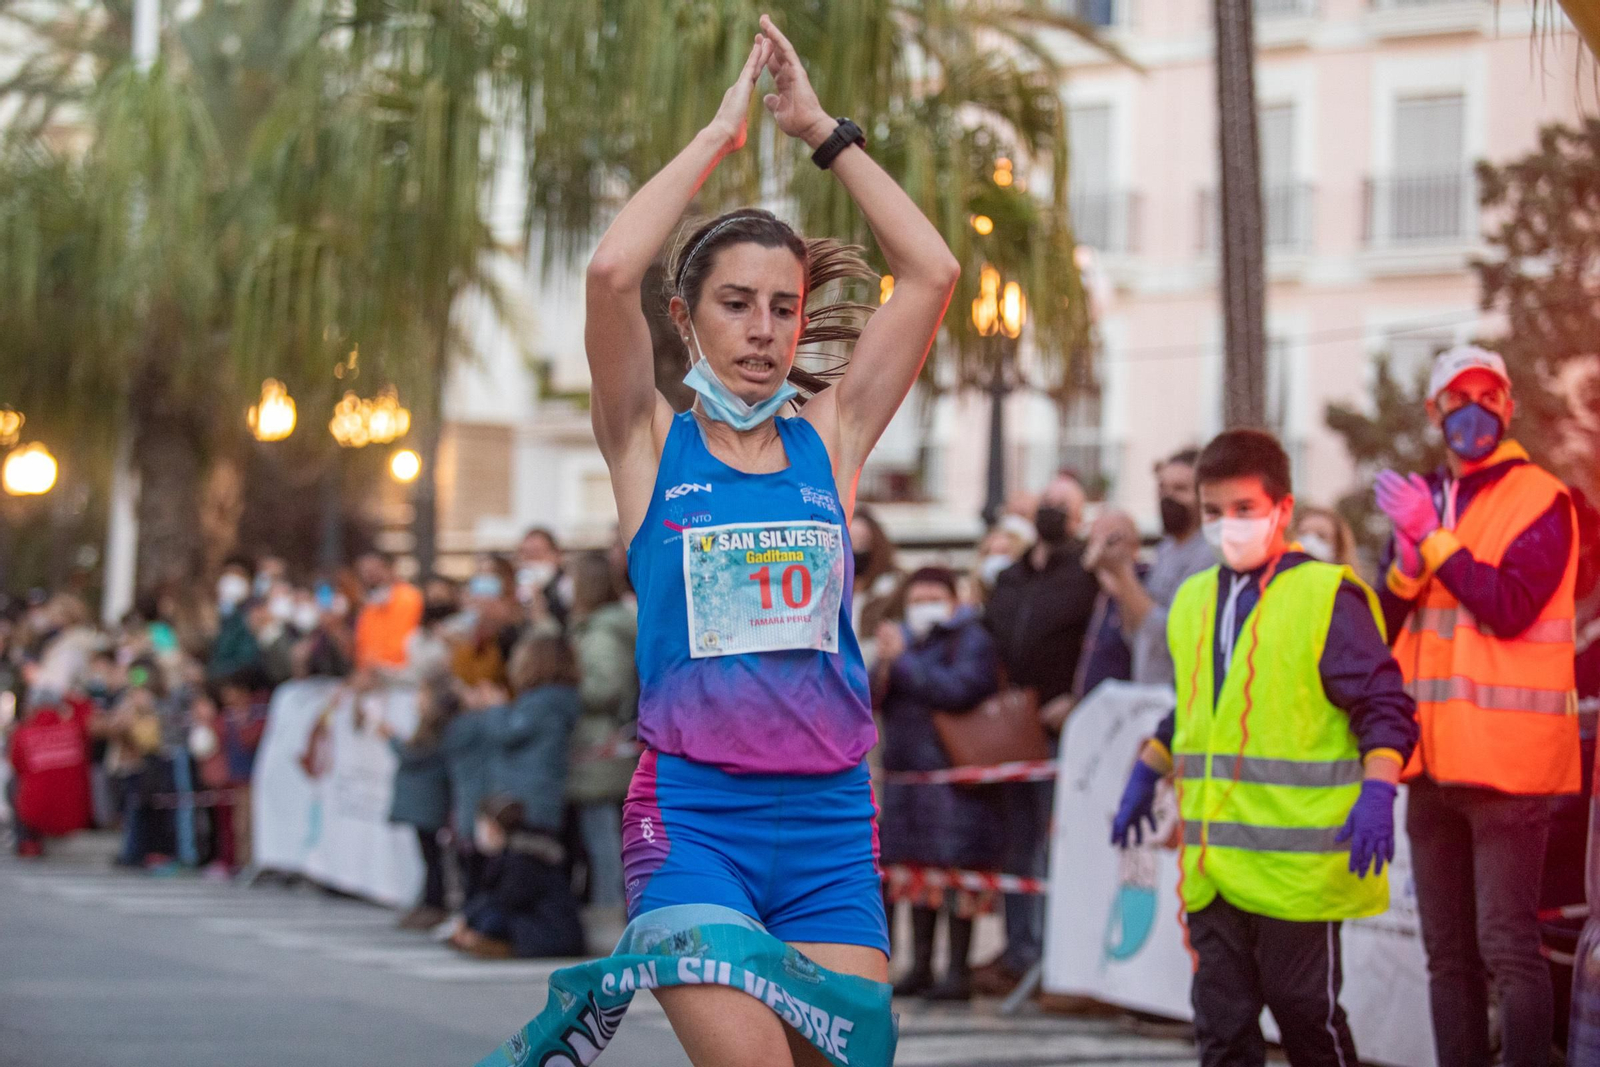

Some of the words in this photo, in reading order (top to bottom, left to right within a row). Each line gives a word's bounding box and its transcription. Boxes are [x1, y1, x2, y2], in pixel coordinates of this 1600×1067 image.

[718, 533, 755, 551] SAN
[759, 530, 836, 549] SILVESTRE
[746, 549, 804, 564] Gaditana
[749, 564, 812, 610] 10
[749, 615, 785, 627] TAMARA
[601, 960, 660, 997] SAN
[677, 956, 855, 1065] SILVESTRE
